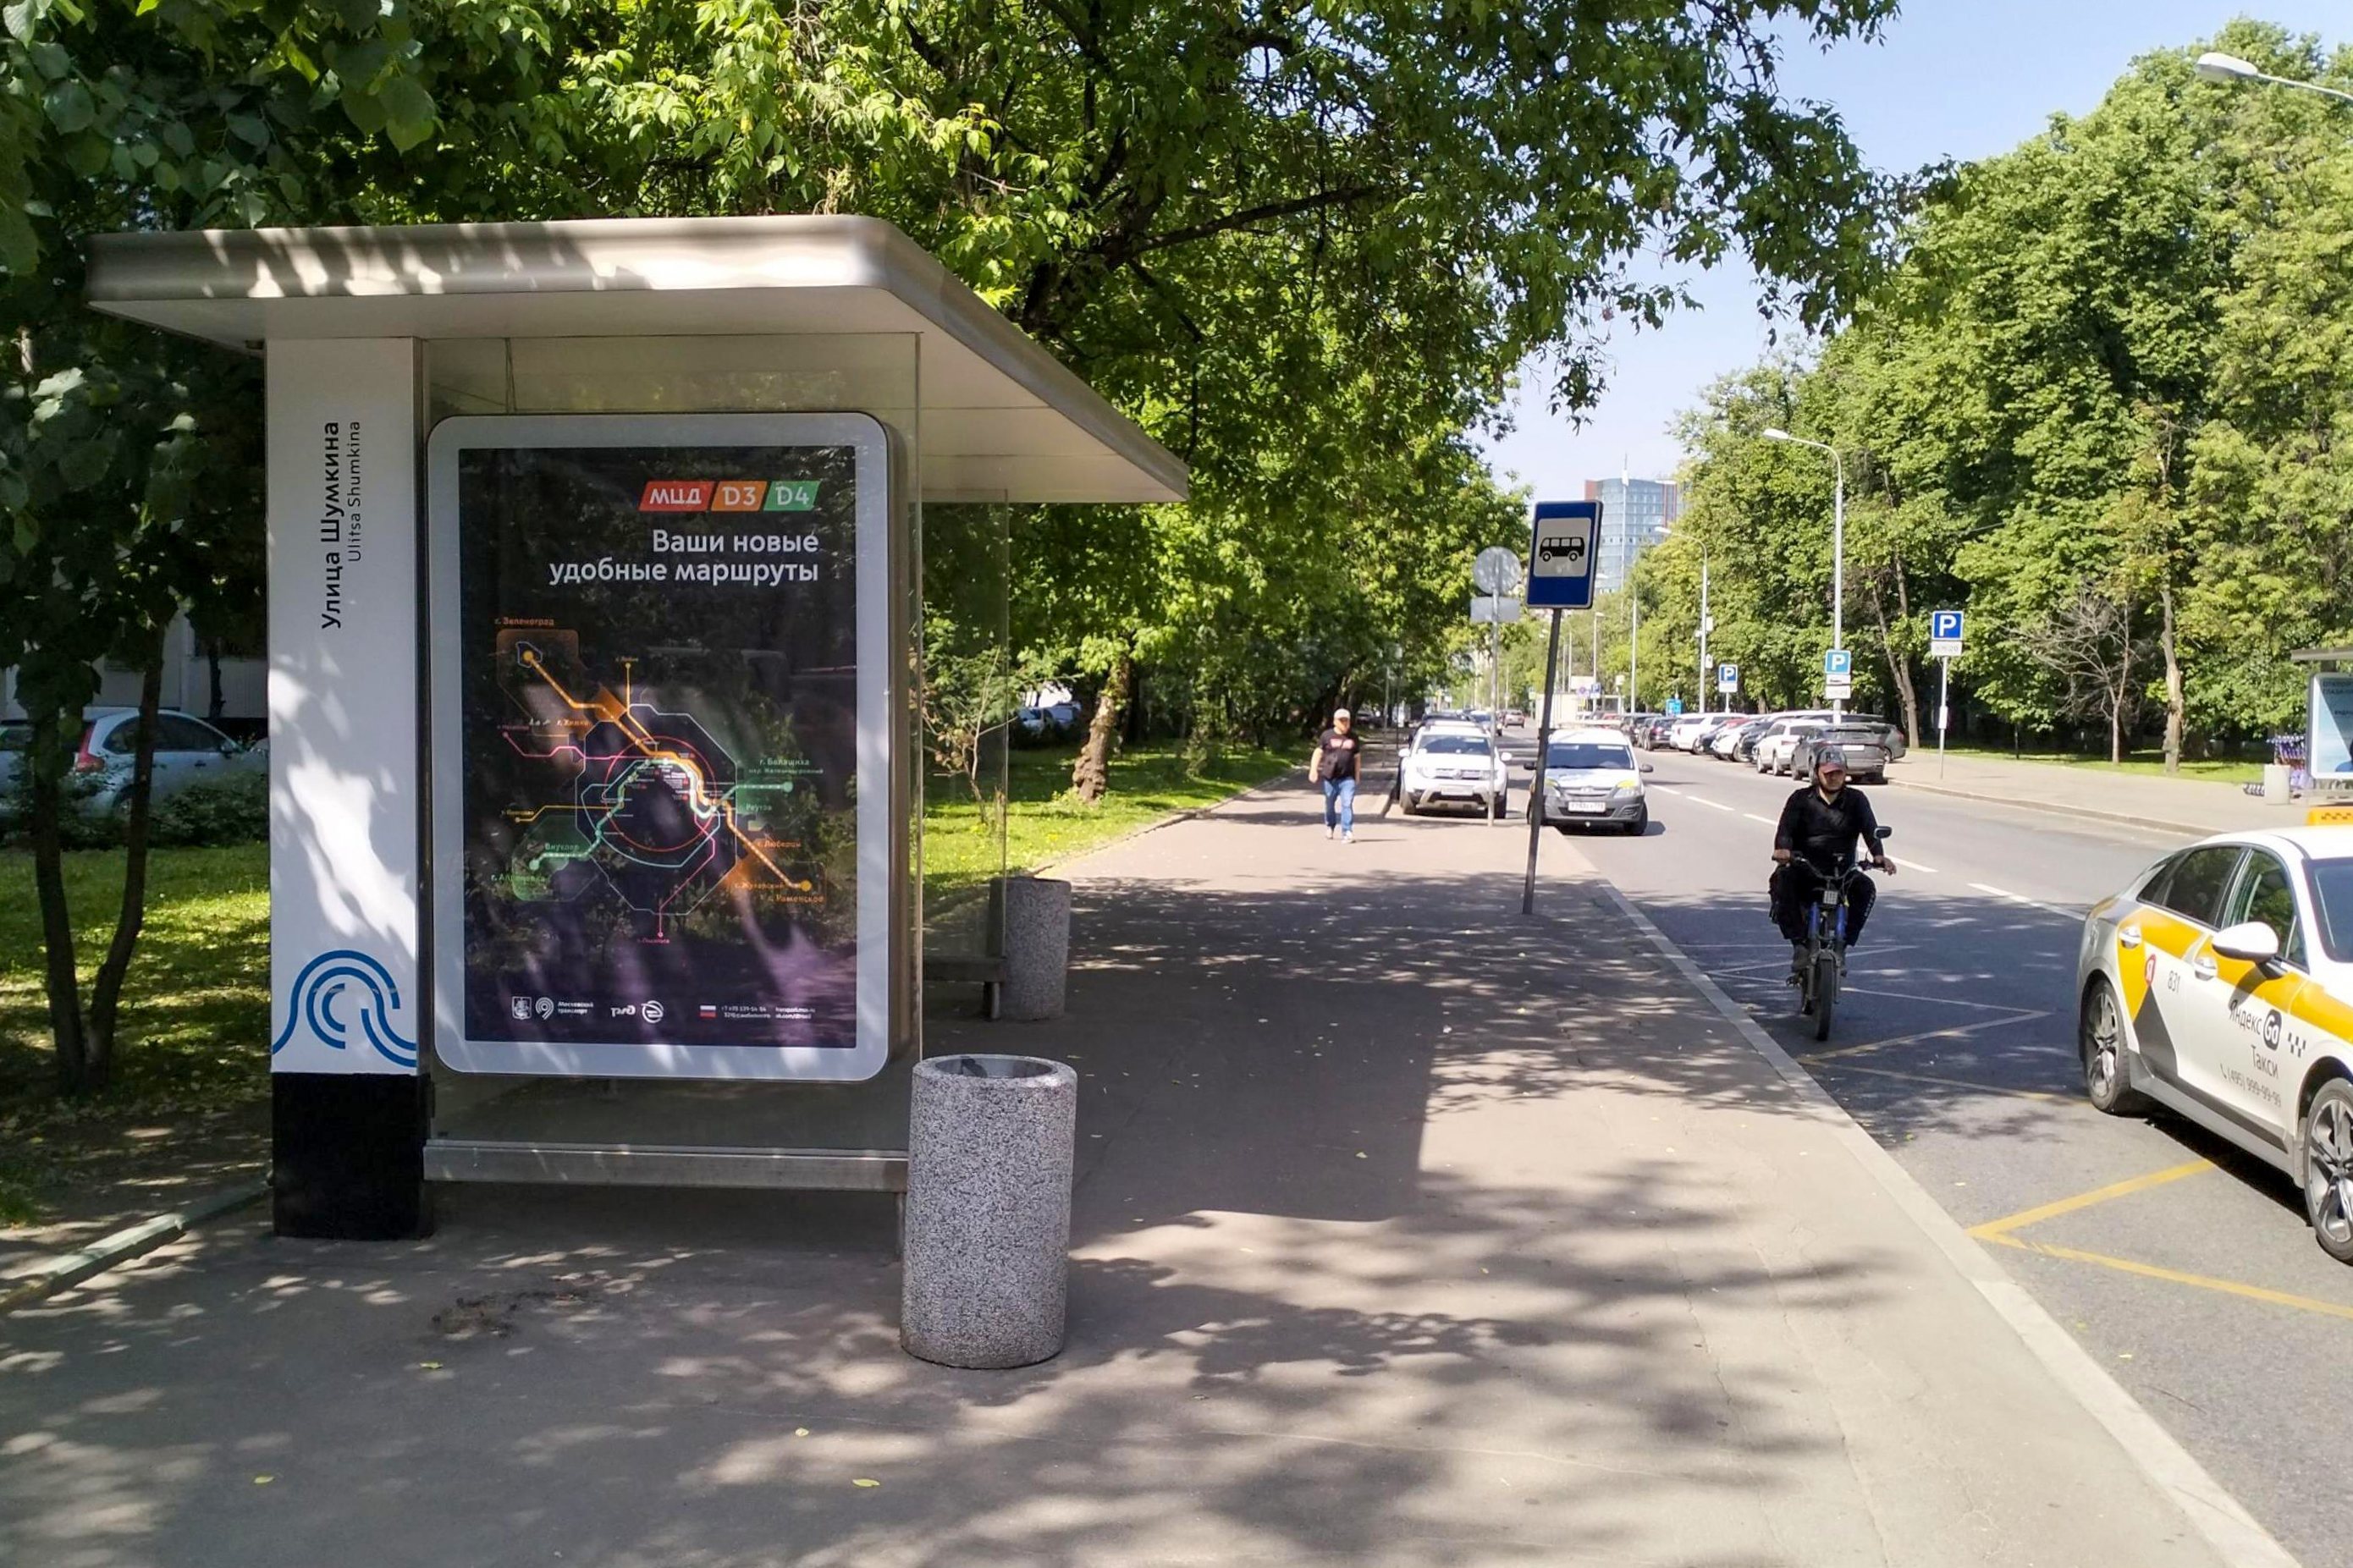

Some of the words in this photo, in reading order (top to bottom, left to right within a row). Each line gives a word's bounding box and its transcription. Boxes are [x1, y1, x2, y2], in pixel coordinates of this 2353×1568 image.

[320, 421, 344, 542] Шумкина
[346, 421, 361, 508] Shumkina
[649, 487, 702, 506] МЦД
[723, 487, 756, 506] D3
[775, 487, 809, 506] D4
[347, 513, 361, 562] Ulitsa
[653, 529, 724, 553] Ваши
[734, 534, 818, 553] новые
[549, 557, 667, 586] удобные
[675, 563, 818, 586] маршруты
[321, 552, 344, 630] Улица
[1939, 614, 1957, 637] P
[1832, 654, 1846, 671] P
[2229, 999, 2262, 1035] Яндекс
[2264, 1014, 2280, 1045] Go
[2251, 1043, 2279, 1080] Такси
